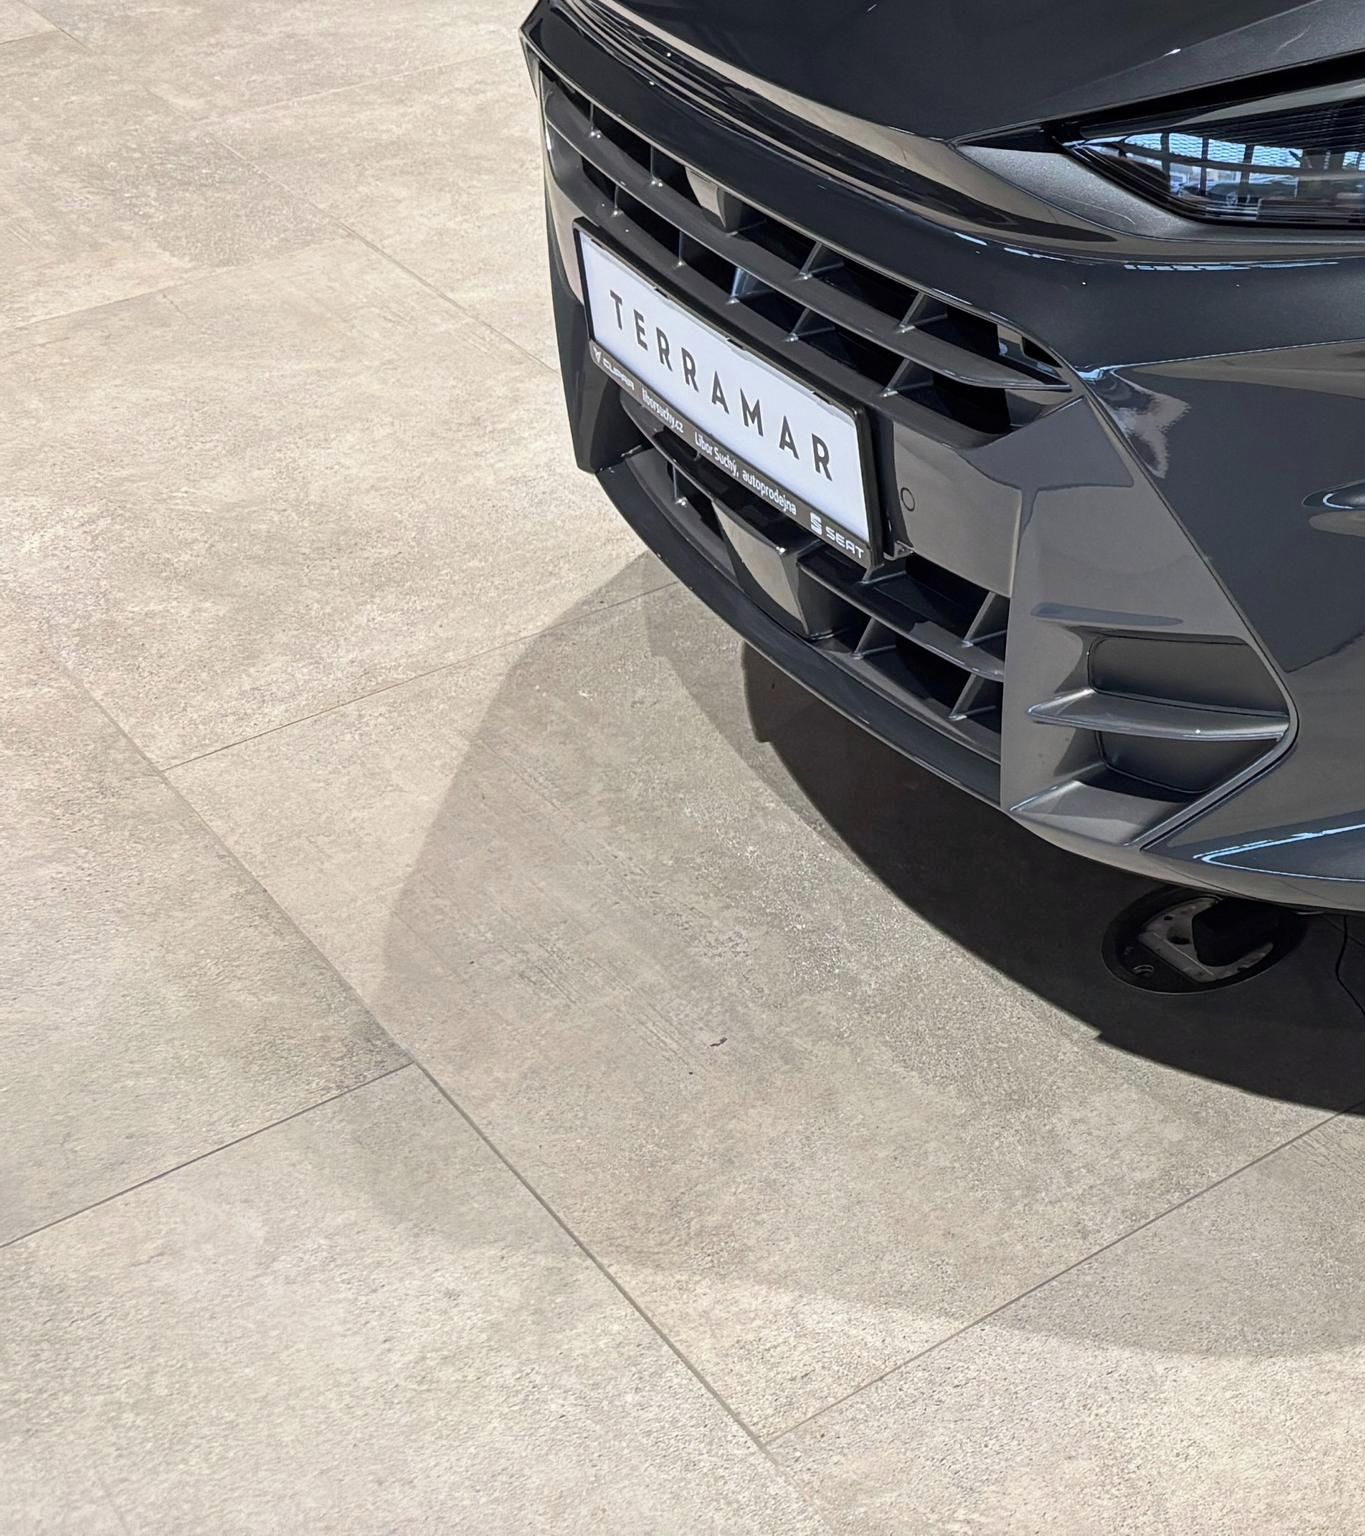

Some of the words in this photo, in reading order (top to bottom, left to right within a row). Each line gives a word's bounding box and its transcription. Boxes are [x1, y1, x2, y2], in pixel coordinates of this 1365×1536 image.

[602, 358, 635, 392] CUPRA
[609, 289, 834, 482] TERRAMAR
[694, 431, 713, 456] Libor
[742, 469, 797, 516] autoprodejna
[826, 526, 865, 560] SEAT
